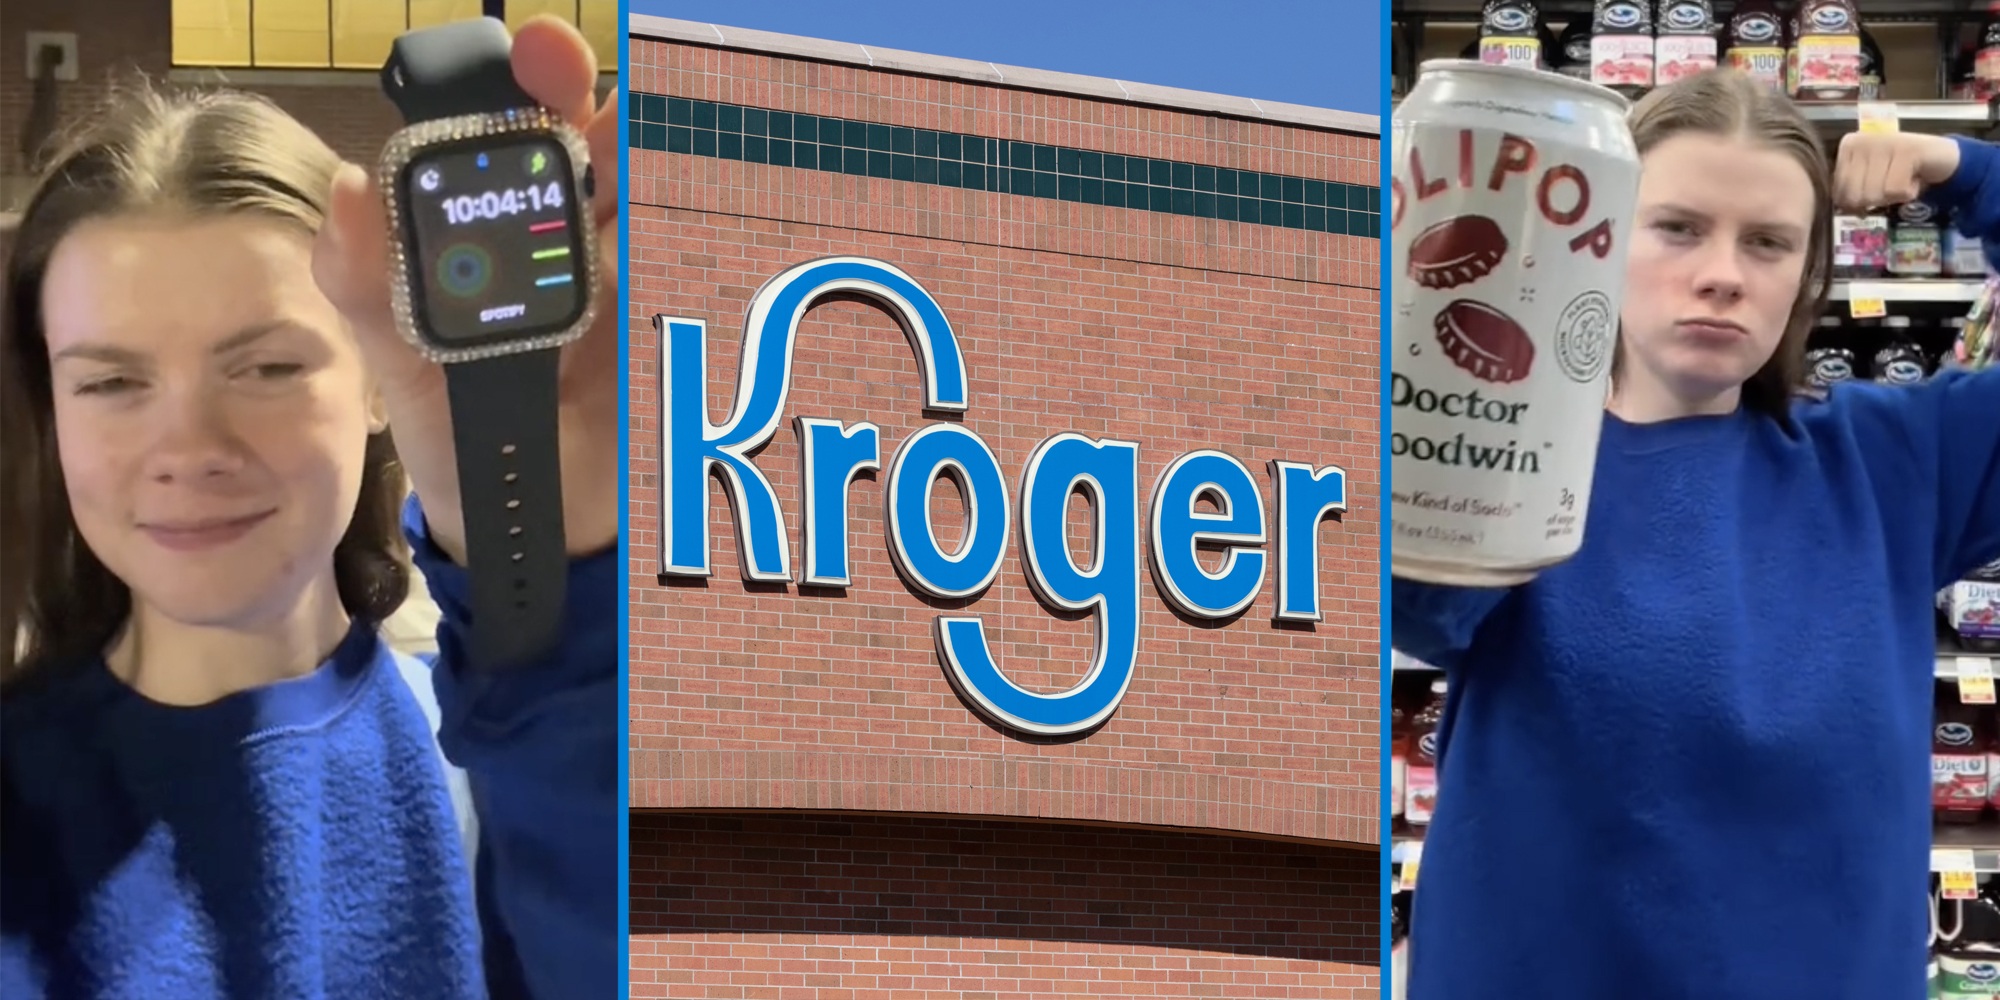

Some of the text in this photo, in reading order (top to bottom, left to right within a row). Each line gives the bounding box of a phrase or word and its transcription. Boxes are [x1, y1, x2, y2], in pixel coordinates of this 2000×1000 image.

[442, 181, 564, 225] 10:04:14
[1391, 371, 1529, 425] Doctor
[655, 255, 1348, 736] Kroger
